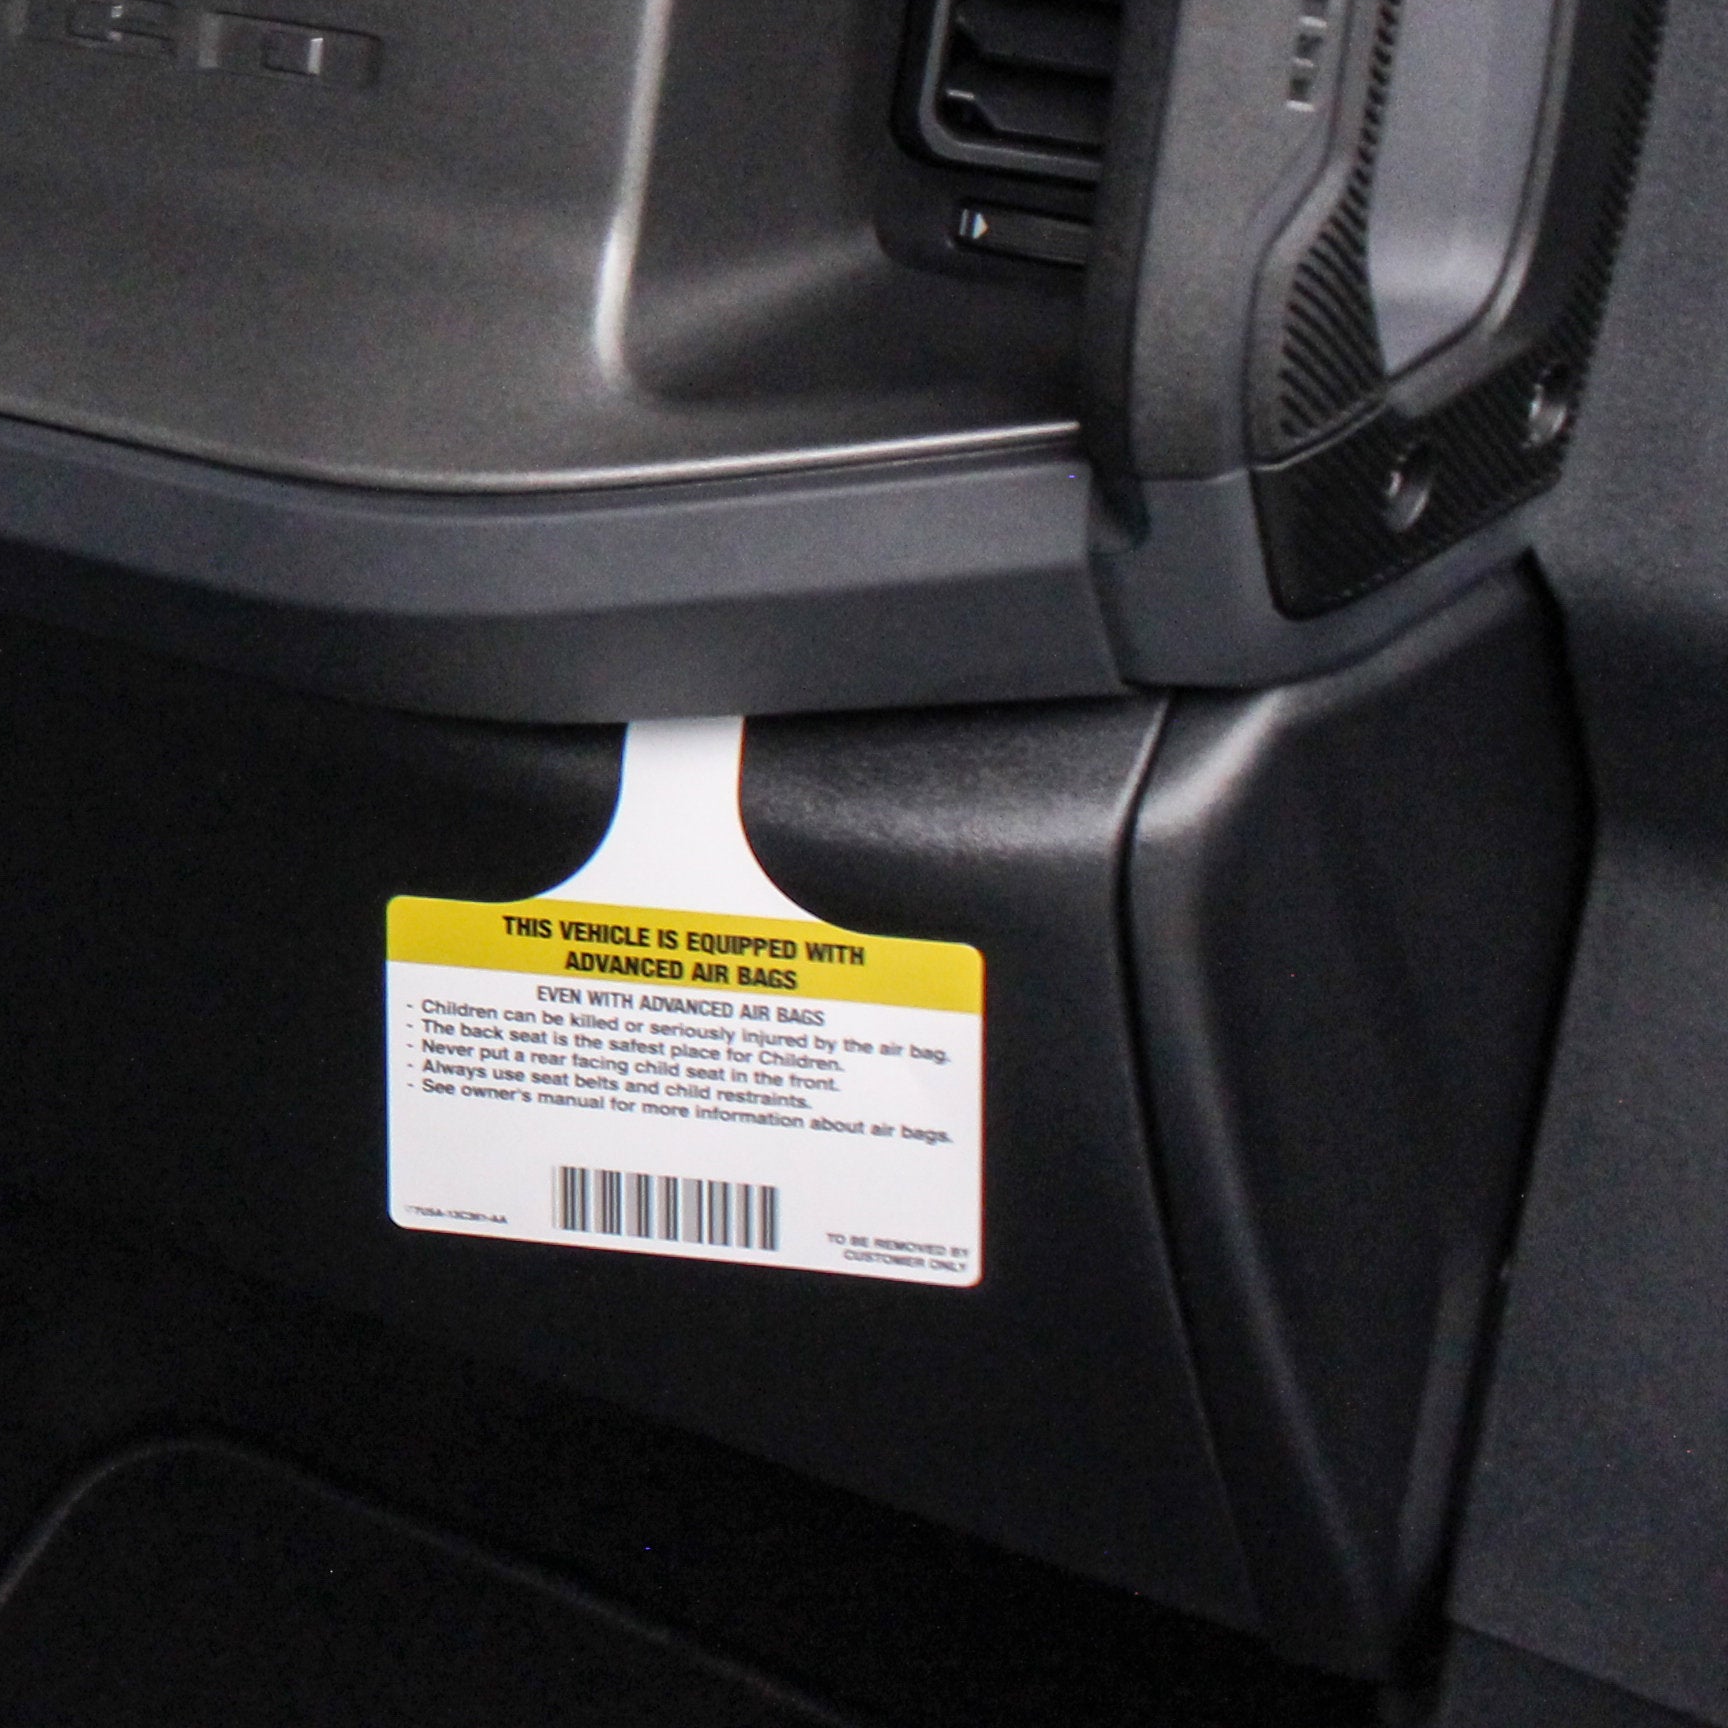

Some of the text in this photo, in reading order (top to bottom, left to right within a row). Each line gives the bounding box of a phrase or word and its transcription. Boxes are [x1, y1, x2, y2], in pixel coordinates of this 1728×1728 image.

[503, 916, 865, 965] THIS VEHICLE IS EQUIPPED WITH
[564, 951, 797, 990] ADVANCED AIR BAGS
[537, 986, 825, 1026] EVEN WITH ADVANCED AIR BAGS
[421, 999, 951, 1065] Children can be killed or seriously injured by the air bag.
[421, 1018, 845, 1072] The back seat is the safest place for Children.
[421, 1039, 841, 1091] Never put a rear facing child seat in the front.
[422, 1059, 812, 1109] Always use seat belts and child restraints.
[422, 1078, 953, 1145] See owner's manual for more information about air bags.
